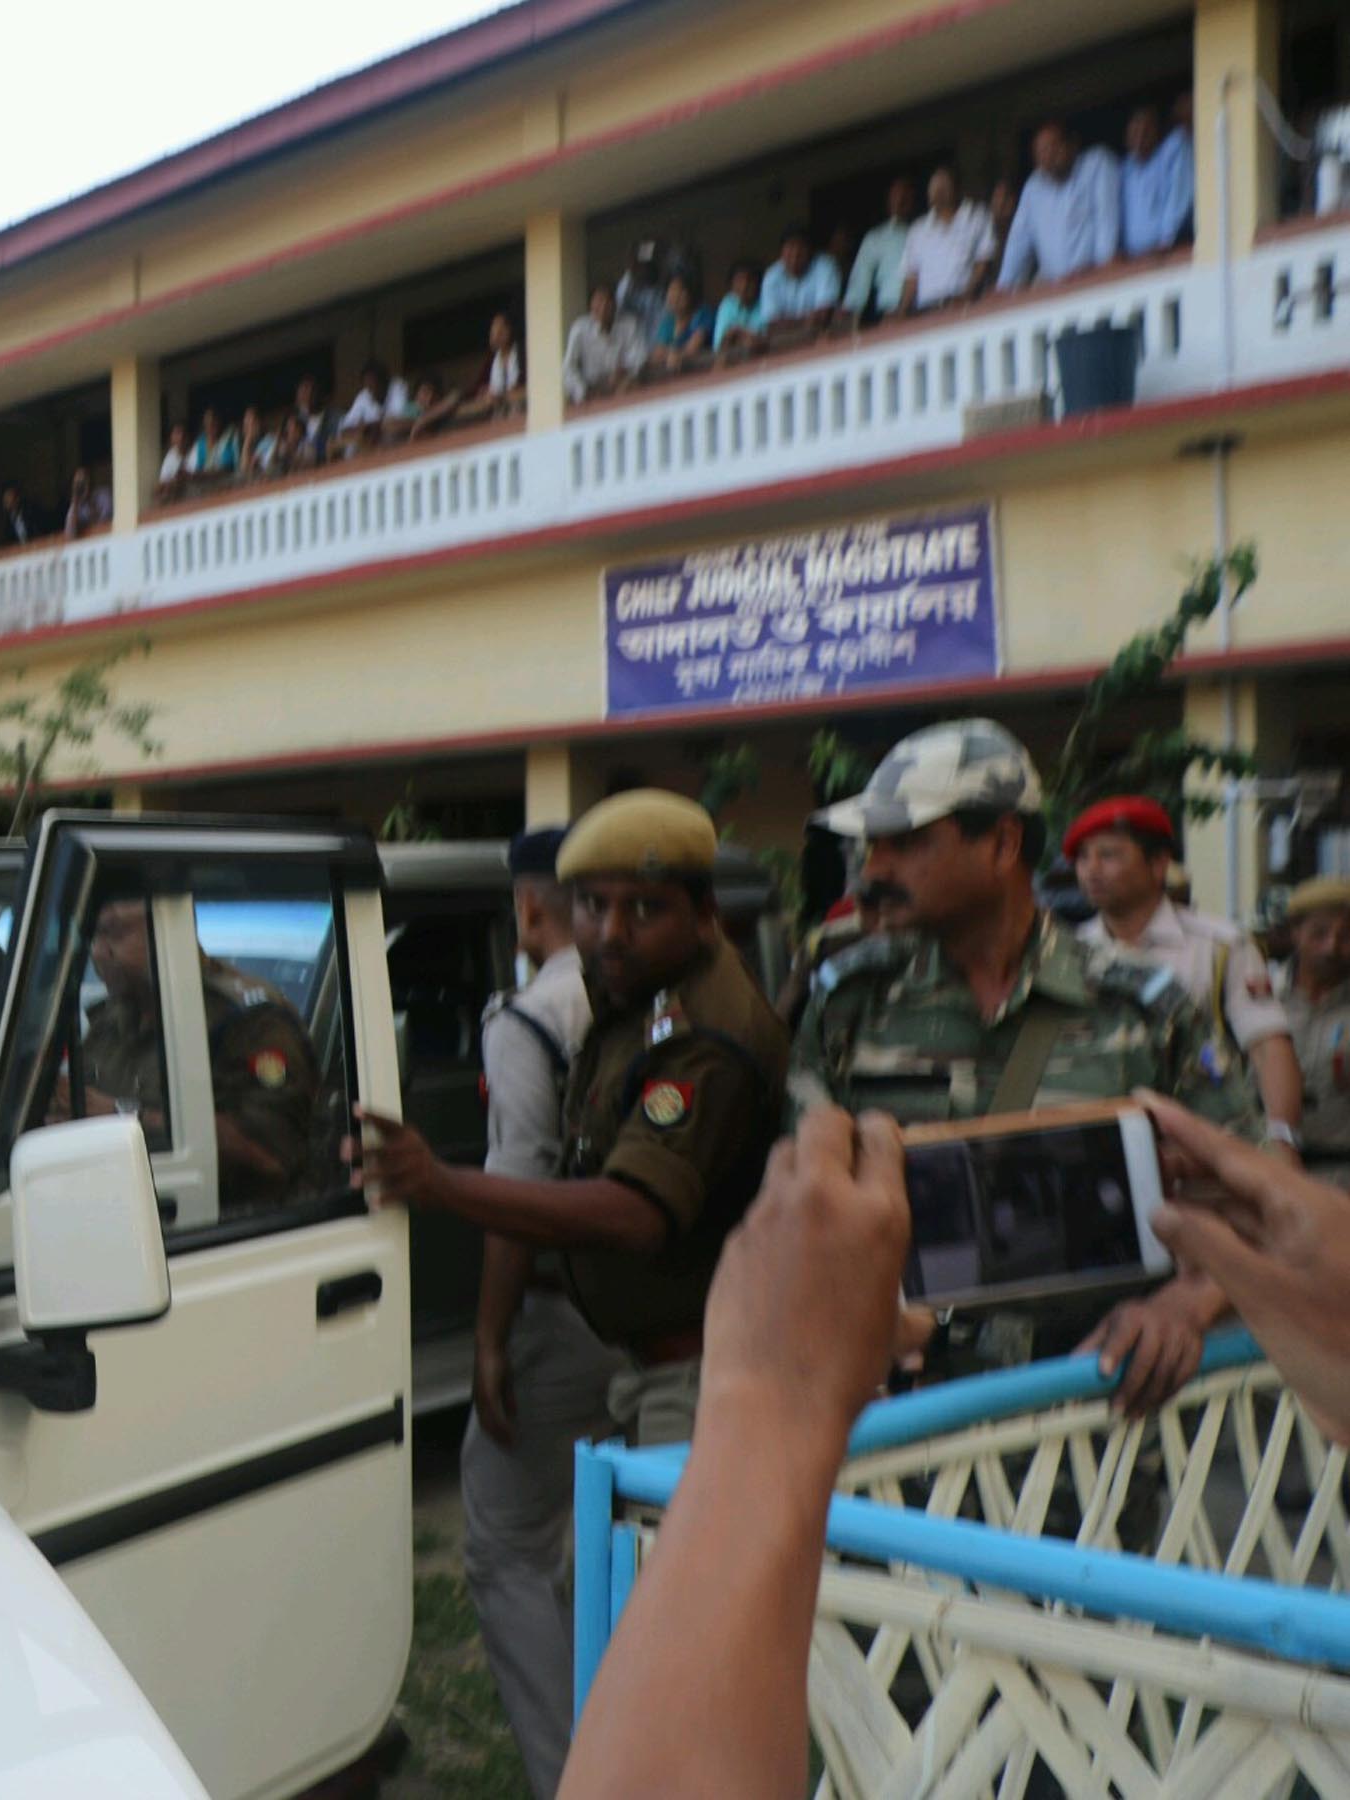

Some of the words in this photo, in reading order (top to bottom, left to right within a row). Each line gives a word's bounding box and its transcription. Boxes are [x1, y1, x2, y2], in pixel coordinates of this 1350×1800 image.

[616, 575, 683, 622] CHIEF
[686, 556, 802, 612] JUDICIAL
[804, 523, 981, 590] MAGISTRATE
